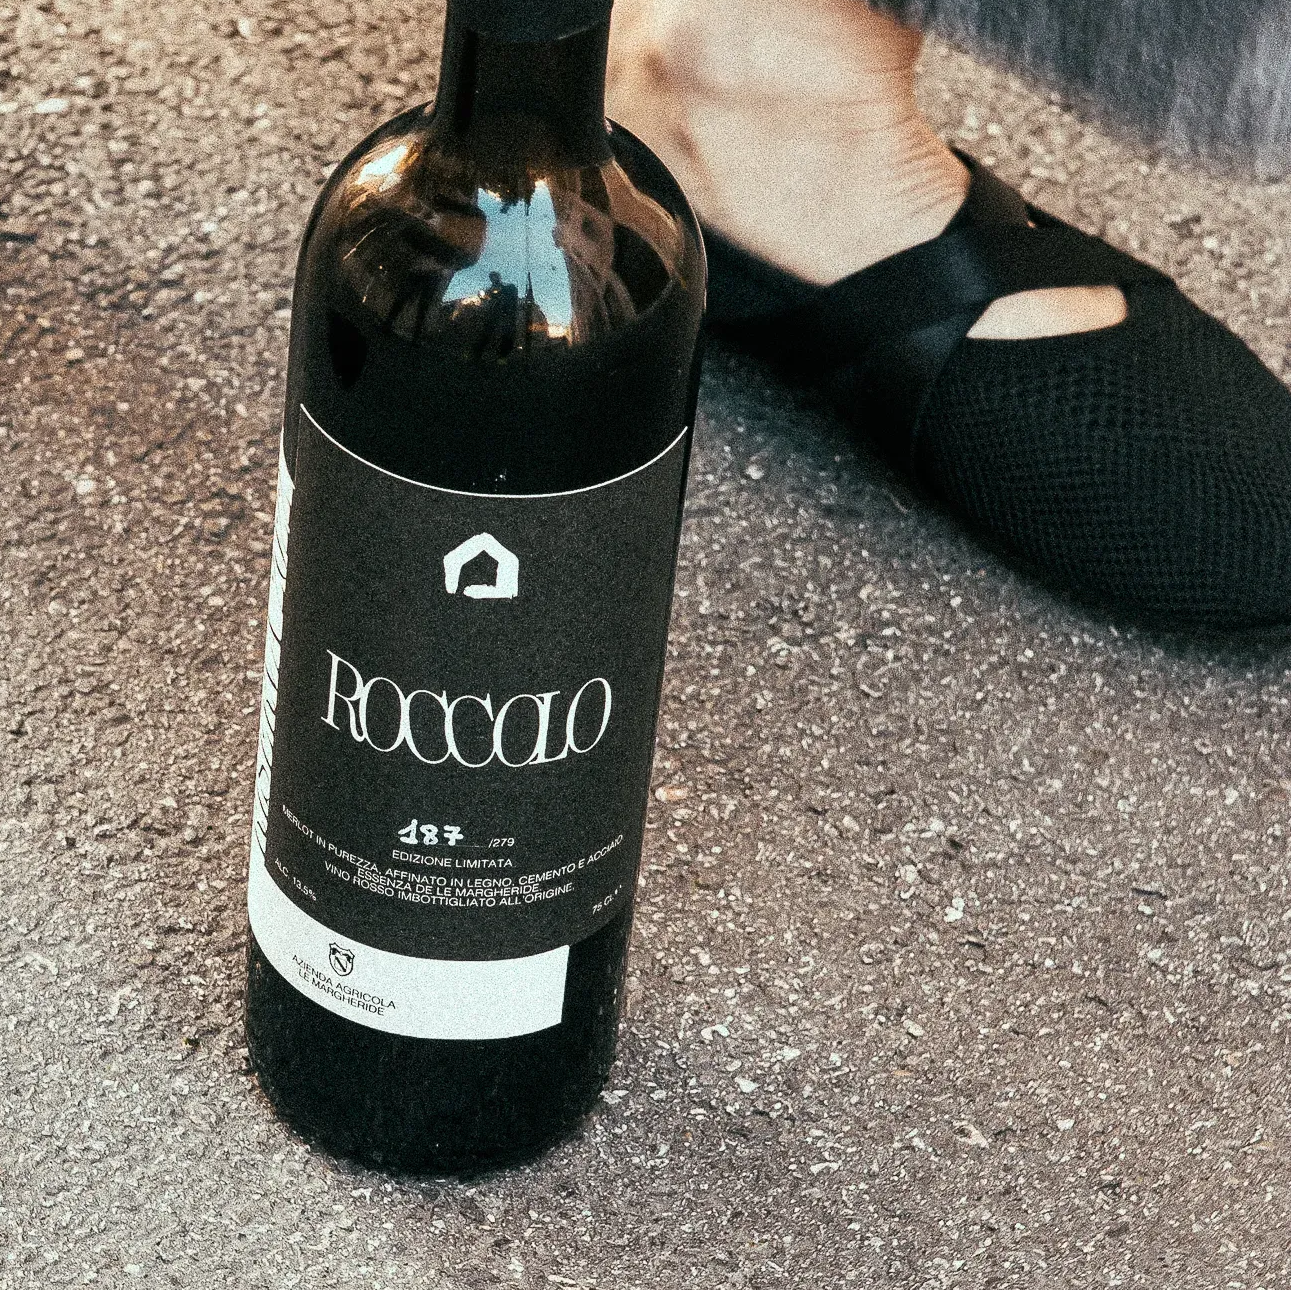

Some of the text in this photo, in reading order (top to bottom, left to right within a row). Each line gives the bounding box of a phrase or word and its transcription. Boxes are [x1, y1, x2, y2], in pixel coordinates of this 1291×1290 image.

[321, 649, 612, 768] ROCCOLO
[282, 804, 314, 839] MERLOT
[316, 835, 326, 849] IN
[385, 868, 447, 887] AFFINATO
[450, 879, 464, 887] IN
[518, 863, 576, 886] CEMENTO
[578, 858, 586, 868] E
[587, 834, 623, 865] ACCIAIO
[398, 818, 515, 849] 187 /279
[357, 868, 412, 892] ESSENZA
[415, 885, 434, 895] DE
[436, 887, 452, 897] LE
[392, 849, 513, 869] EDIZIONE LIMITATA
[324, 860, 351, 881] VINO
[352, 876, 395, 897] ROSSO
[397, 891, 497, 907] IMBOTTIGLIATO
[292, 954, 397, 1010] AZIENDA AGRICOLA
[298, 968, 385, 1017] LE MARGHERIDE
